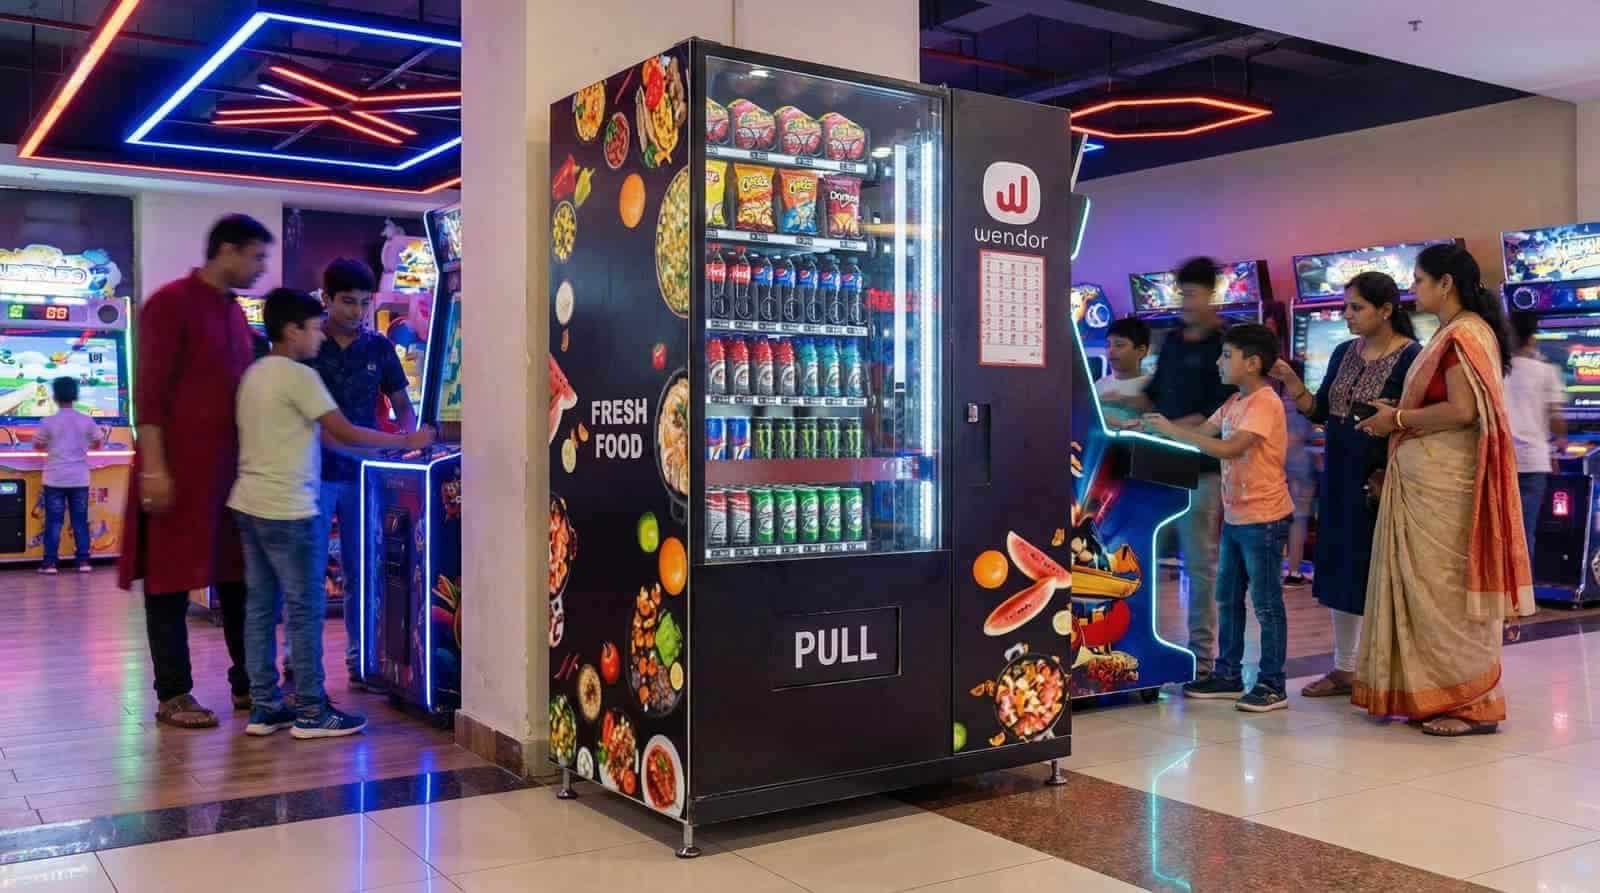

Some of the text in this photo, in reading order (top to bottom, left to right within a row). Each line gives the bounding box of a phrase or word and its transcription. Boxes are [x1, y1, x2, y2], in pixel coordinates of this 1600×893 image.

[974, 227, 1049, 249] wendor
[591, 398, 648, 425] FRESH
[595, 433, 643, 459] FOOD
[795, 625, 878, 669] PULL
